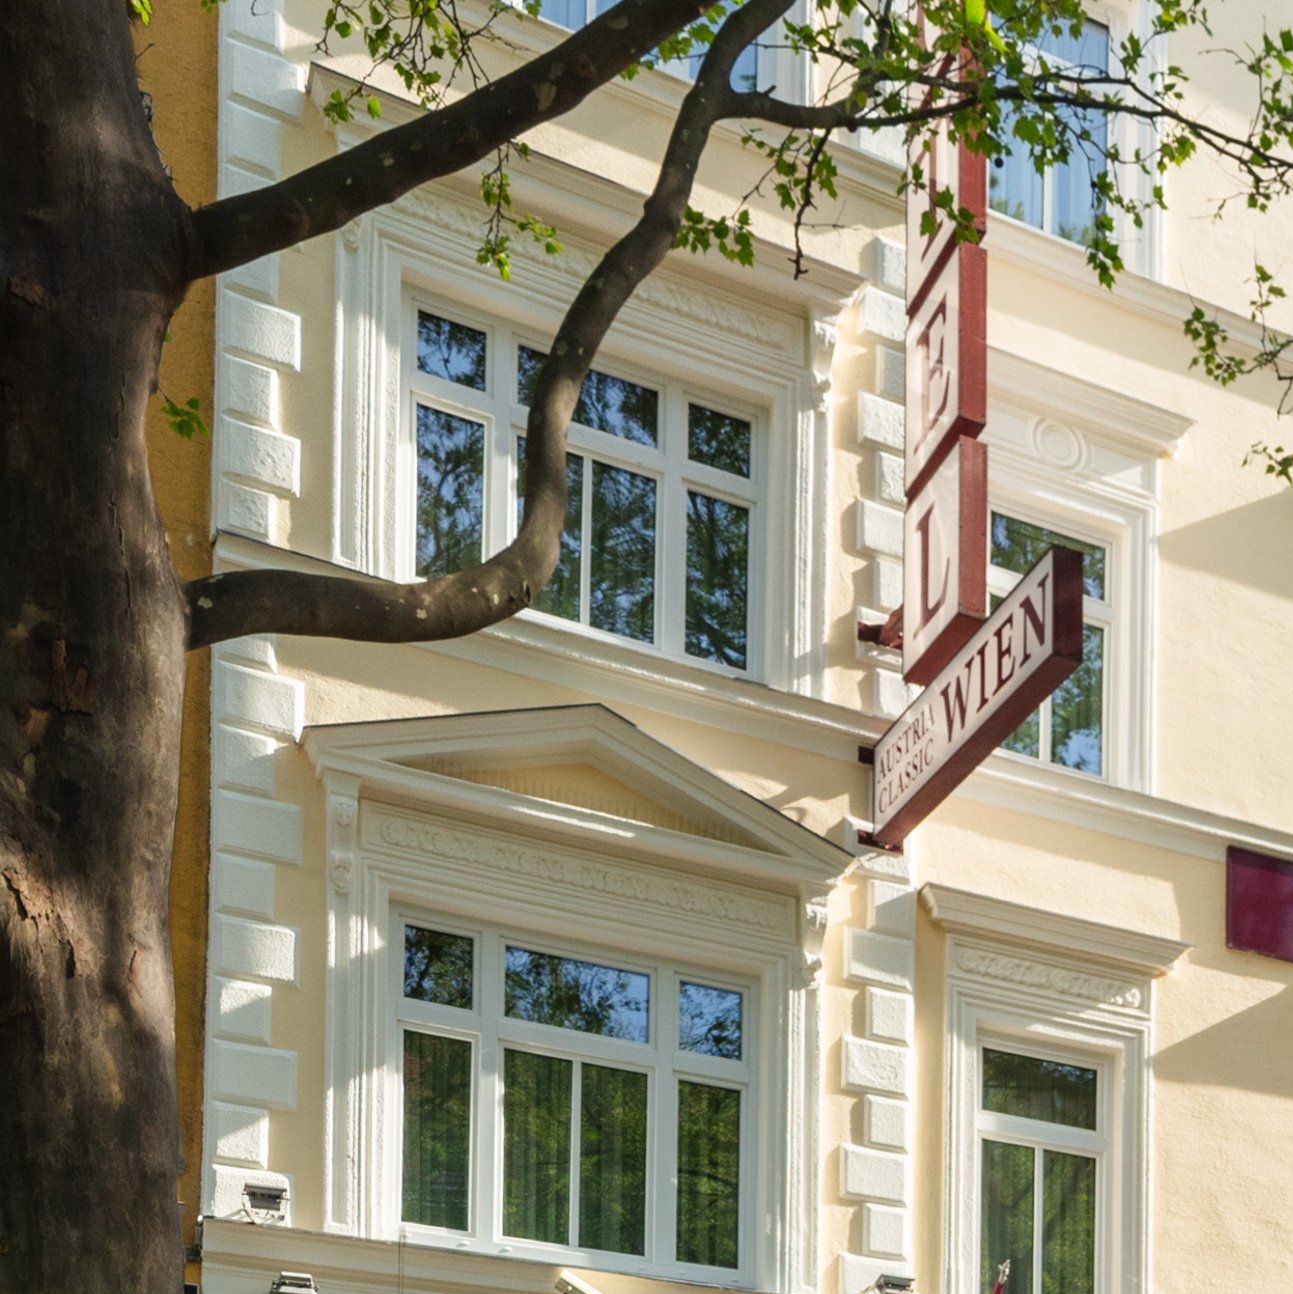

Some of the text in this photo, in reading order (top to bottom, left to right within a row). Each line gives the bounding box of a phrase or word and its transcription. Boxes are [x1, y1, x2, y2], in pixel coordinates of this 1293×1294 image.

[940, 573, 1049, 743] WIEN
[877, 703, 935, 783] AUSTRIA
[878, 738, 934, 814] CLASSIC
